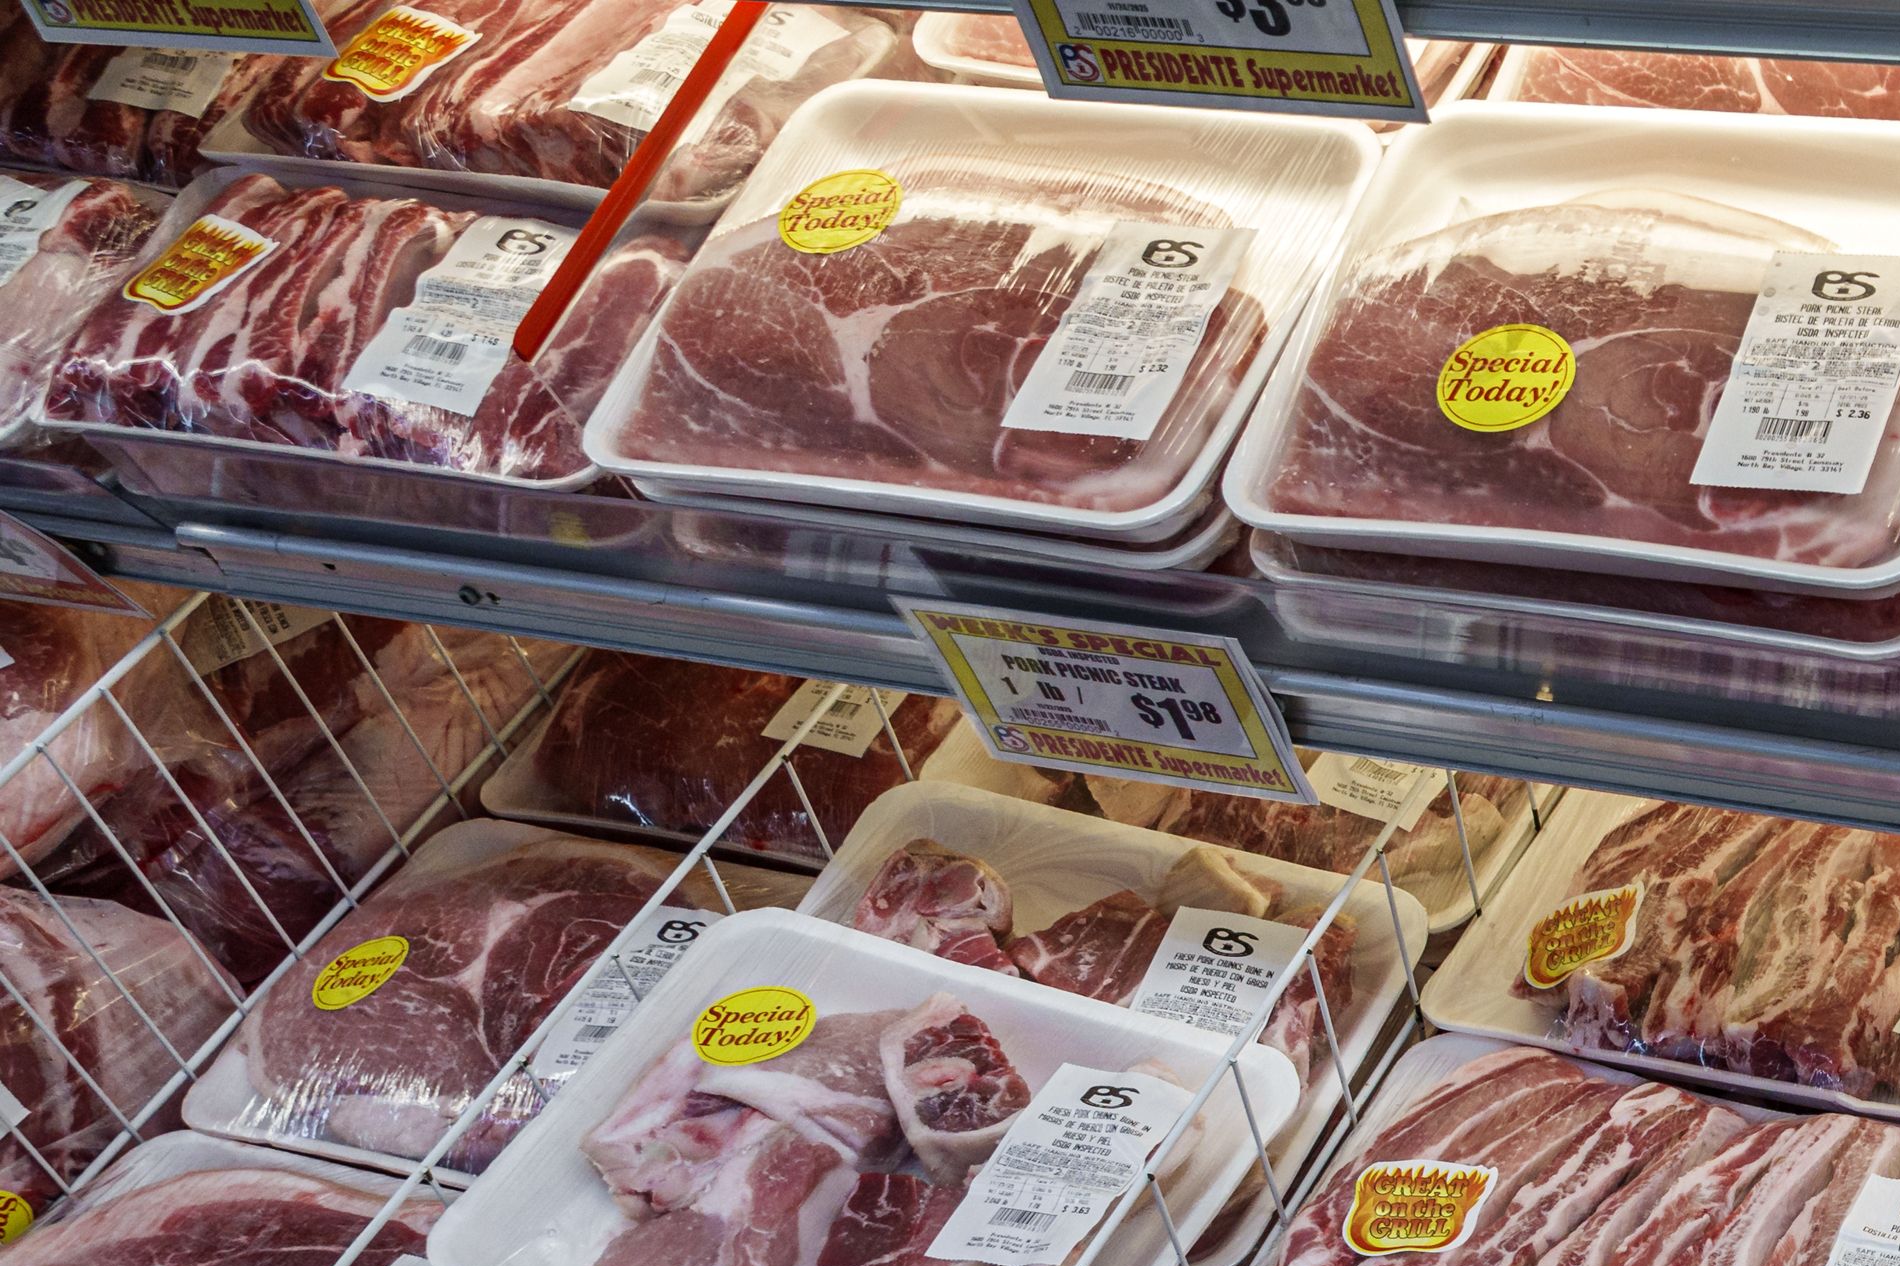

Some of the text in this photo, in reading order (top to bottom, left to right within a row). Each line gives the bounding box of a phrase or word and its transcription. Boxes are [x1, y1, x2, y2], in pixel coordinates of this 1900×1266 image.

[184, 0, 308, 34] Supermarket
[1101, 48, 1402, 98] PRESIDENTE Supermarket
[788, 186, 896, 212] Special
[783, 207, 888, 234] Today!
[1447, 350, 1567, 378] Special
[1446, 377, 1561, 411] Today!
[927, 614, 1221, 667] WEEK'S SPECIAL
[1068, 651, 1120, 666] INSPECTED
[1002, 654, 1186, 694] PORK PICNIC STEAK
[1002, 677, 1018, 695] 1
[1037, 681, 1065, 701] lb
[1031, 732, 1286, 787] PRESIDENTE Supermarket
[328, 950, 405, 974] Special
[318, 966, 394, 993] Today!
[703, 1004, 810, 1026] Special
[698, 1025, 802, 1047] Today!
[1373, 1173, 1469, 1200] GREAT
[1375, 1197, 1455, 1218] on the
[1368, 1217, 1450, 1239] GRILL
